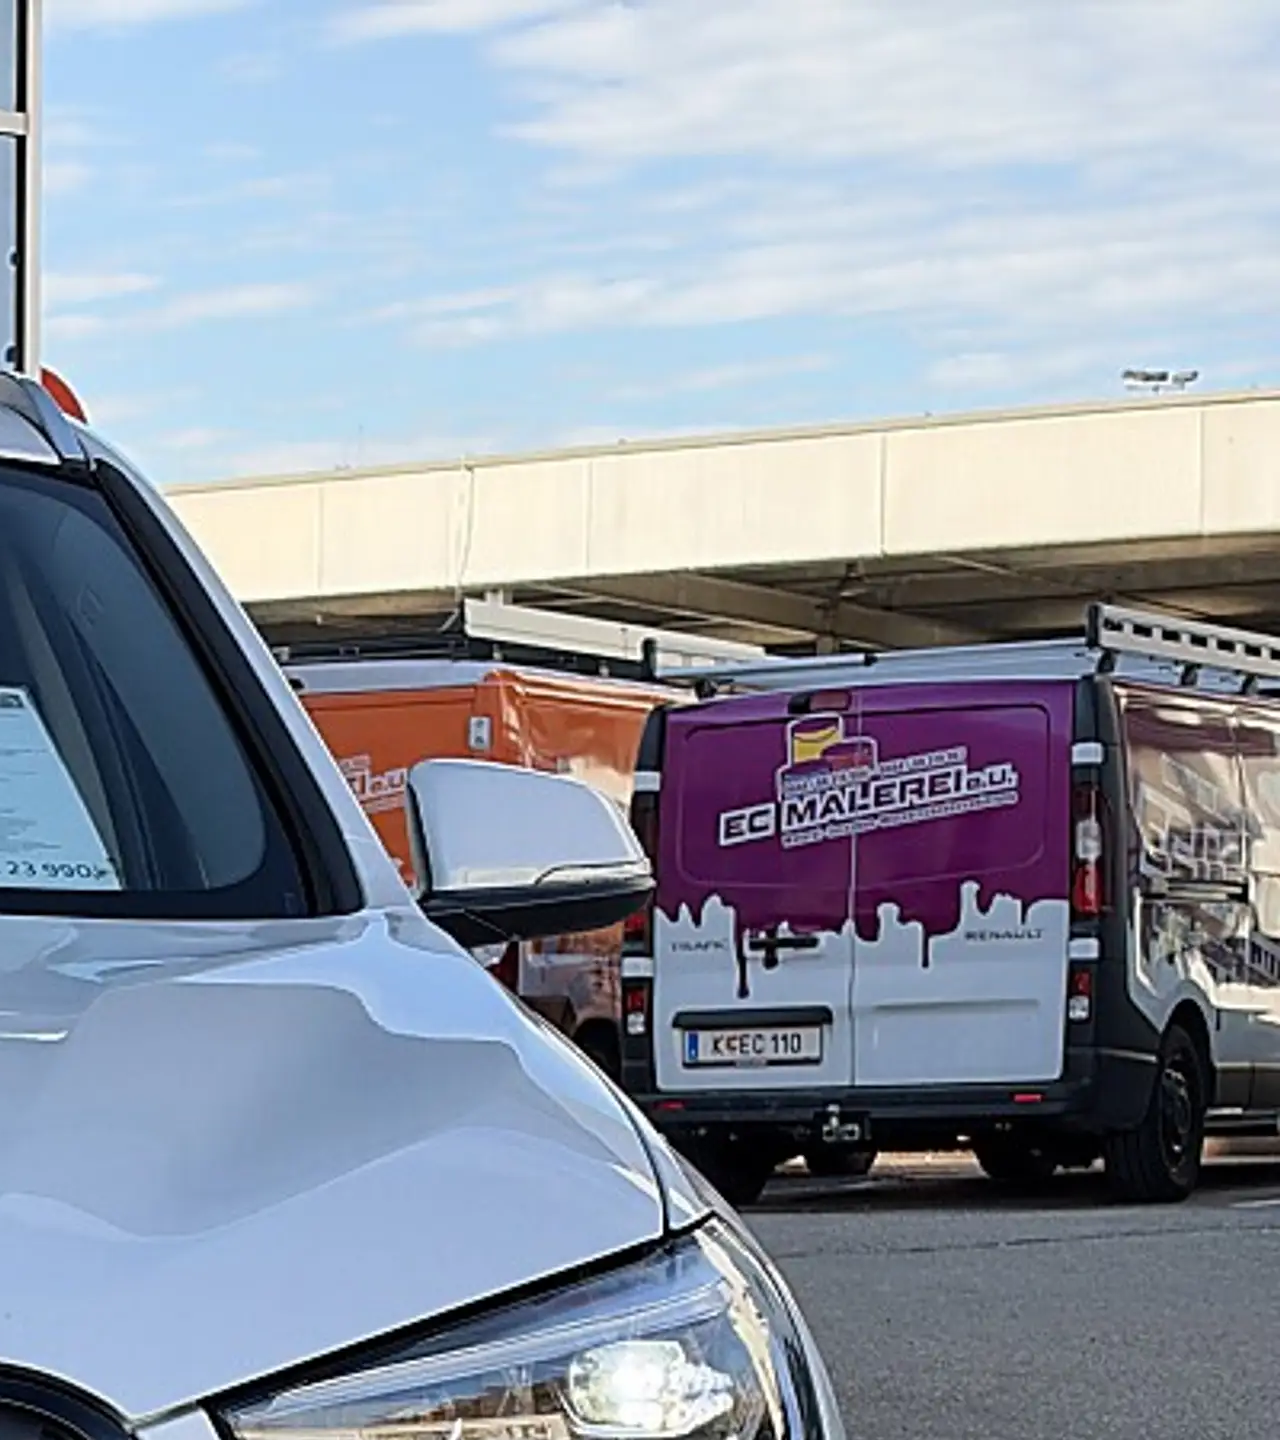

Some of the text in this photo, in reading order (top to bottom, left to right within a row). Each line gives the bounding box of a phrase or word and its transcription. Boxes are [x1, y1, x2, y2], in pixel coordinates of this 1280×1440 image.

[722, 805, 773, 841] EC
[785, 768, 963, 827] MALEREI
[964, 928, 1044, 941] RENAULT
[771, 1032, 802, 1054] 110
